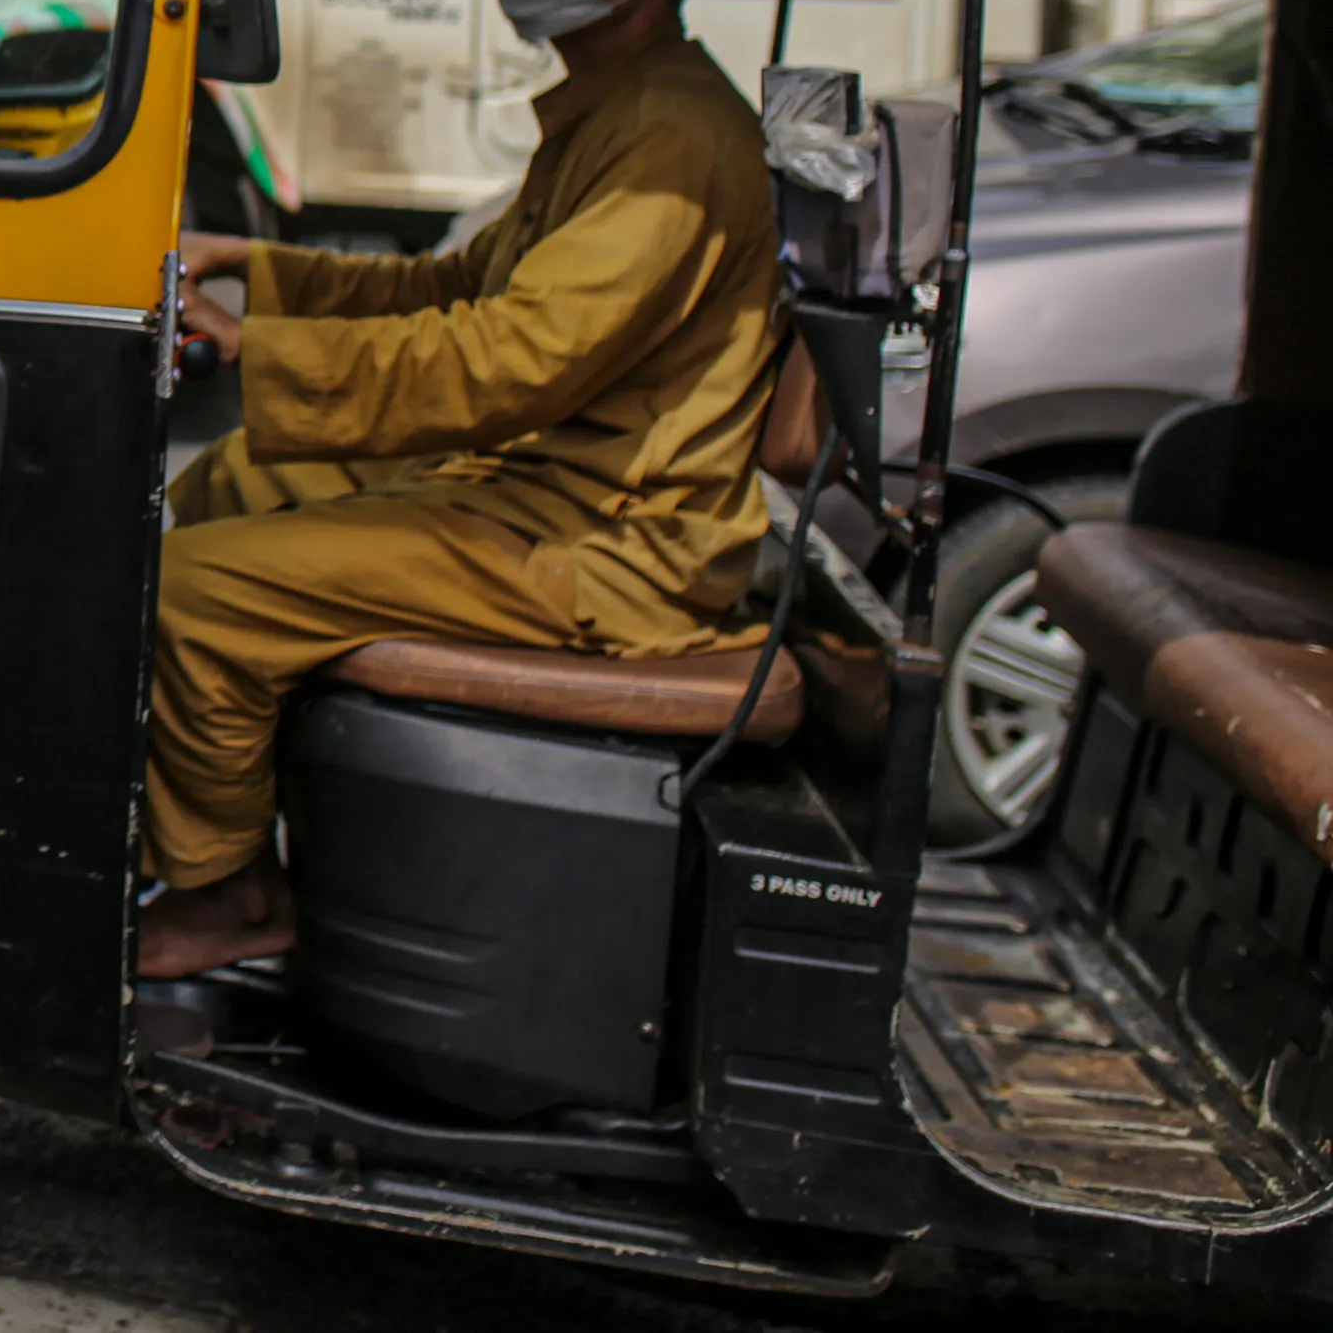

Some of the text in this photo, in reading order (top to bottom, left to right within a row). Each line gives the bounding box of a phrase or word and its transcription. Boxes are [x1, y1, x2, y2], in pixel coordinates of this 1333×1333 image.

[749, 873, 883, 908] 3 PASS ONLY
